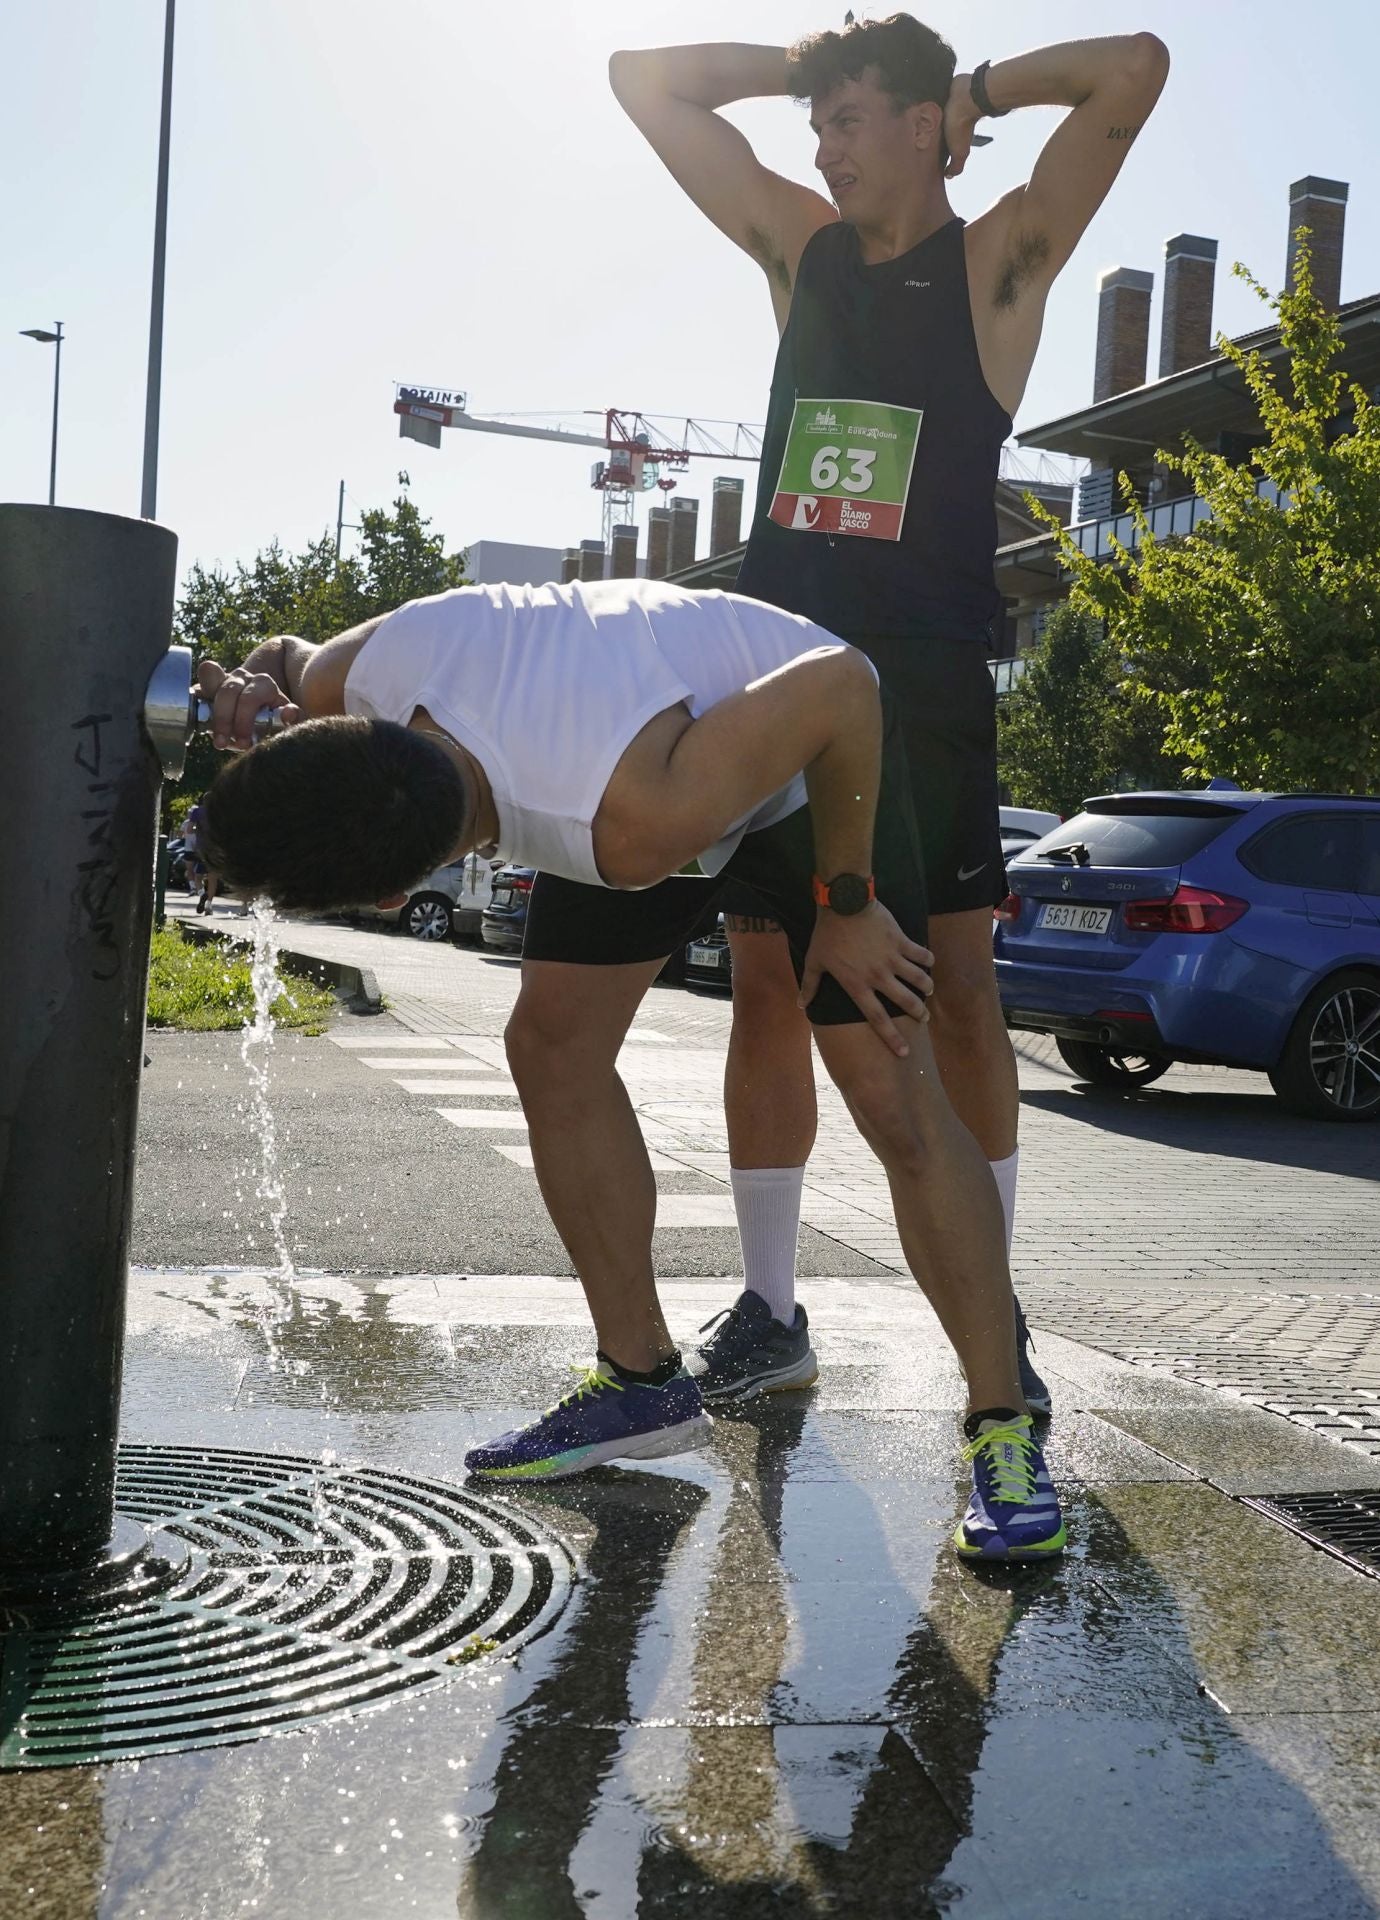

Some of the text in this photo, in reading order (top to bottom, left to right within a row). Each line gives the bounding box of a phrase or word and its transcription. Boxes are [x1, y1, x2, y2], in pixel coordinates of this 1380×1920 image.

[810, 445, 877, 493] 63
[842, 501, 852, 510] EL
[840, 510, 872, 521] DIARIO
[840, 518, 869, 529] VASCO
[1046, 907, 1107, 930] 5631 KDZ
